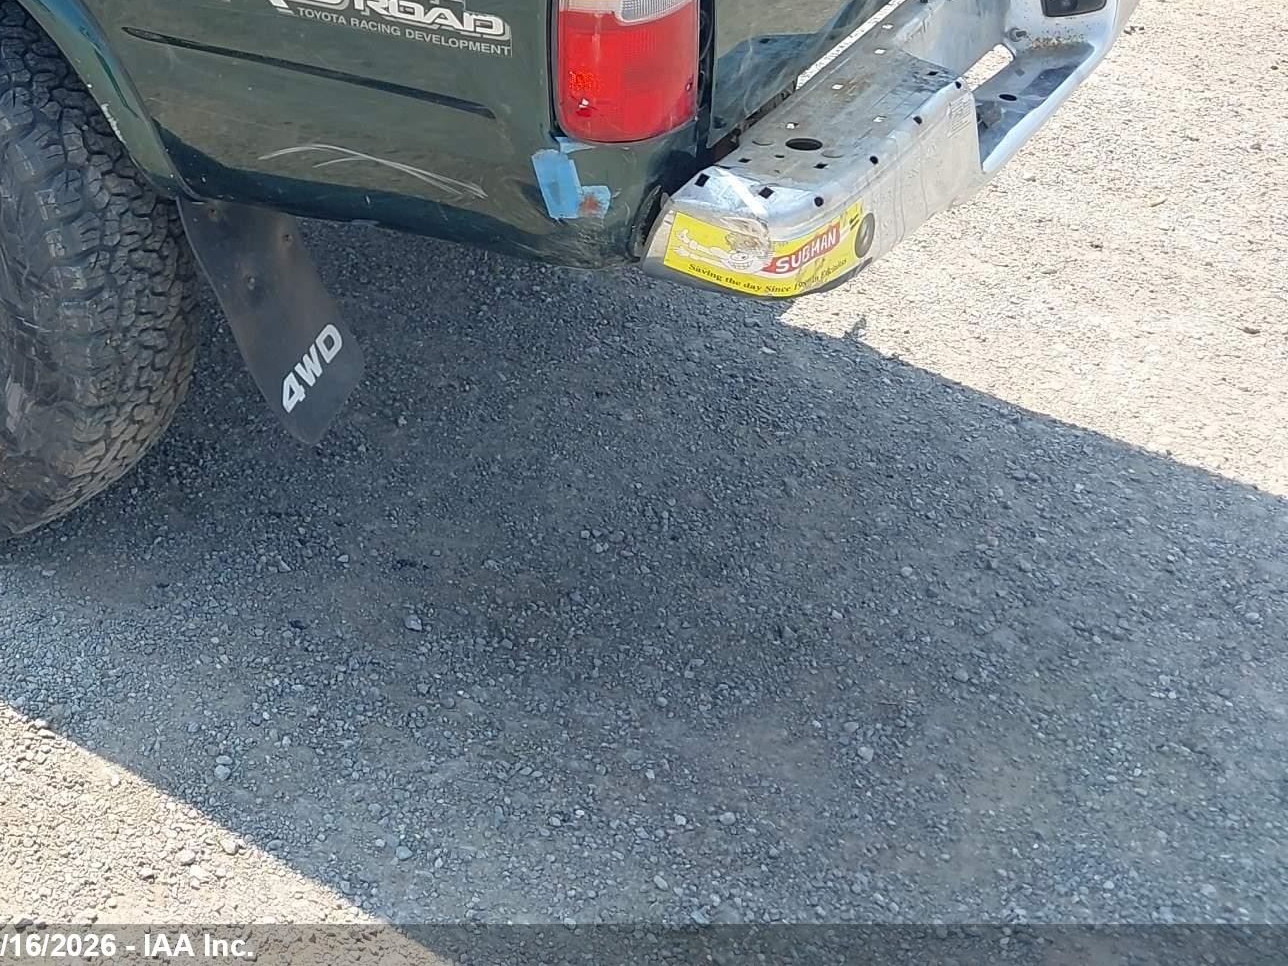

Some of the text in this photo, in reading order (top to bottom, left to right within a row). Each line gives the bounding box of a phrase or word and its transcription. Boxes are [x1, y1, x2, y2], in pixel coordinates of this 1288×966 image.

[297, 7, 511, 57] TOYOTA RACING DEVELOPMENT
[688, 263, 722, 281] Saving
[725, 277, 742, 286] the
[743, 281, 762, 292] day
[764, 285, 792, 293] Since
[282, 323, 343, 414] 4WD
